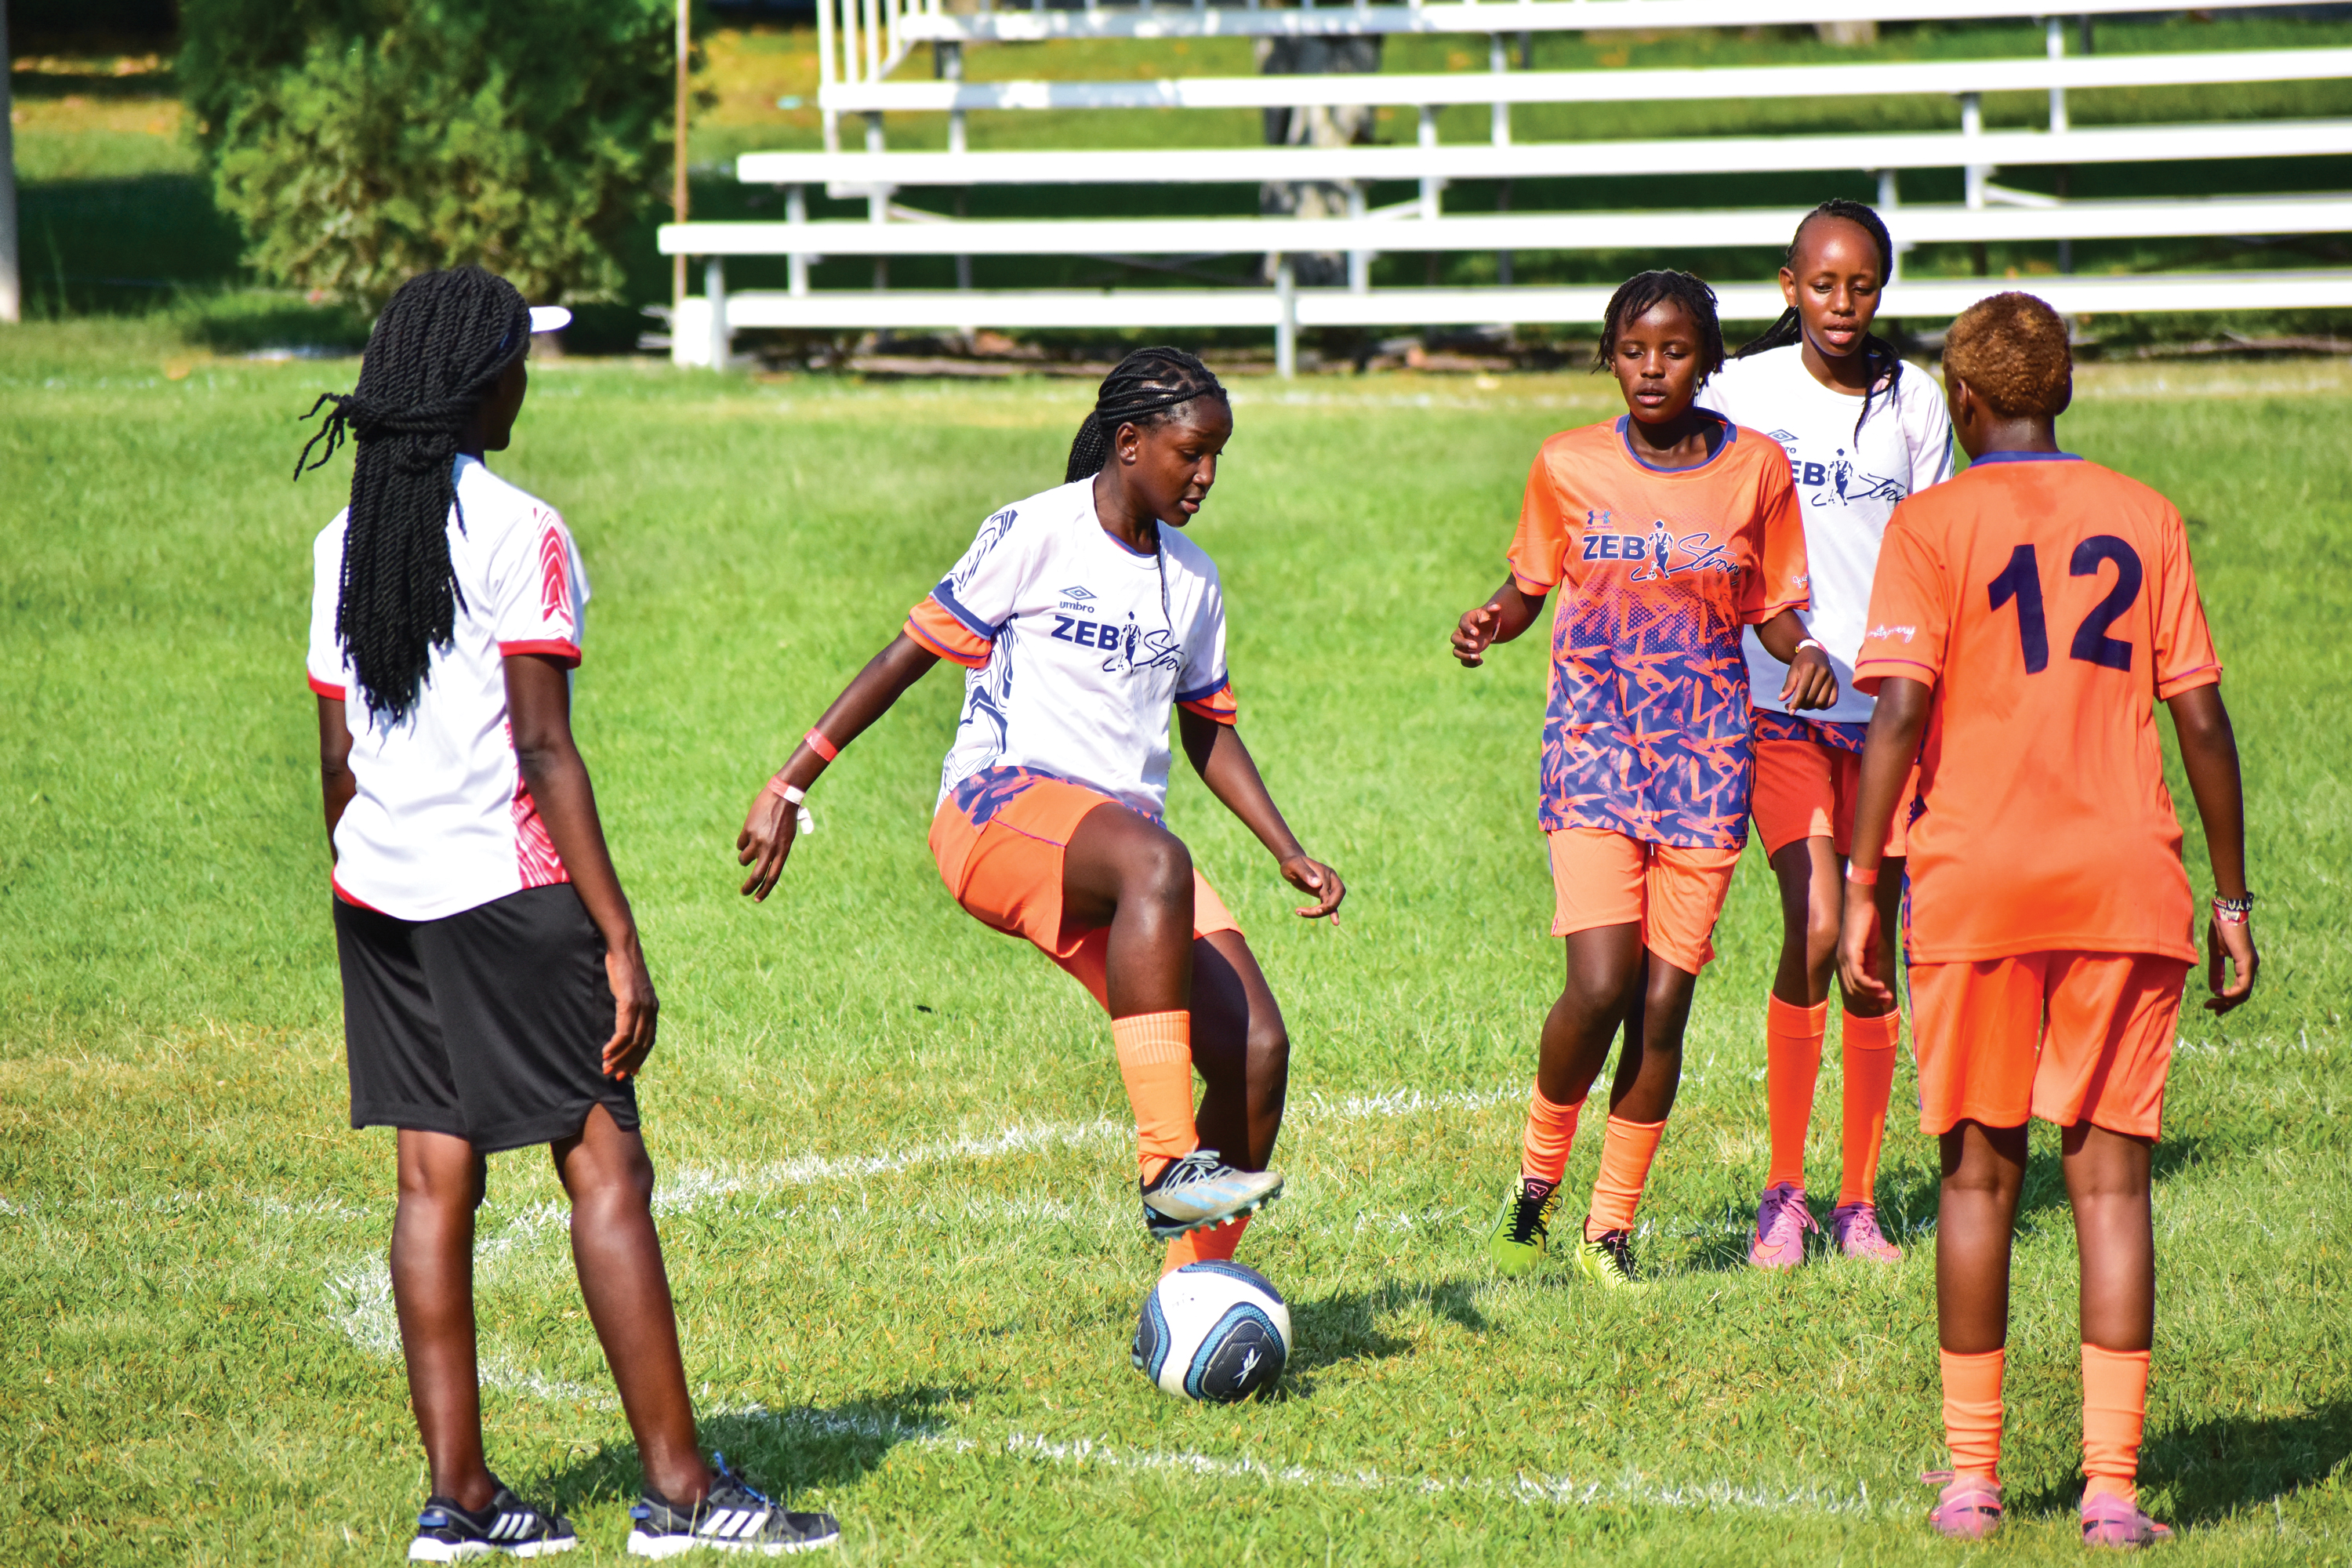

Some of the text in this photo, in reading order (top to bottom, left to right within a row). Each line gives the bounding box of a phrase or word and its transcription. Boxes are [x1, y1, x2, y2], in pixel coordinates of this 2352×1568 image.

[1790, 459, 1826, 487] EB
[1582, 535, 1646, 561] ZEB
[1058, 600, 1095, 614] umbro
[1987, 535, 2143, 676] 12
[1051, 615, 1120, 651] ZEB
